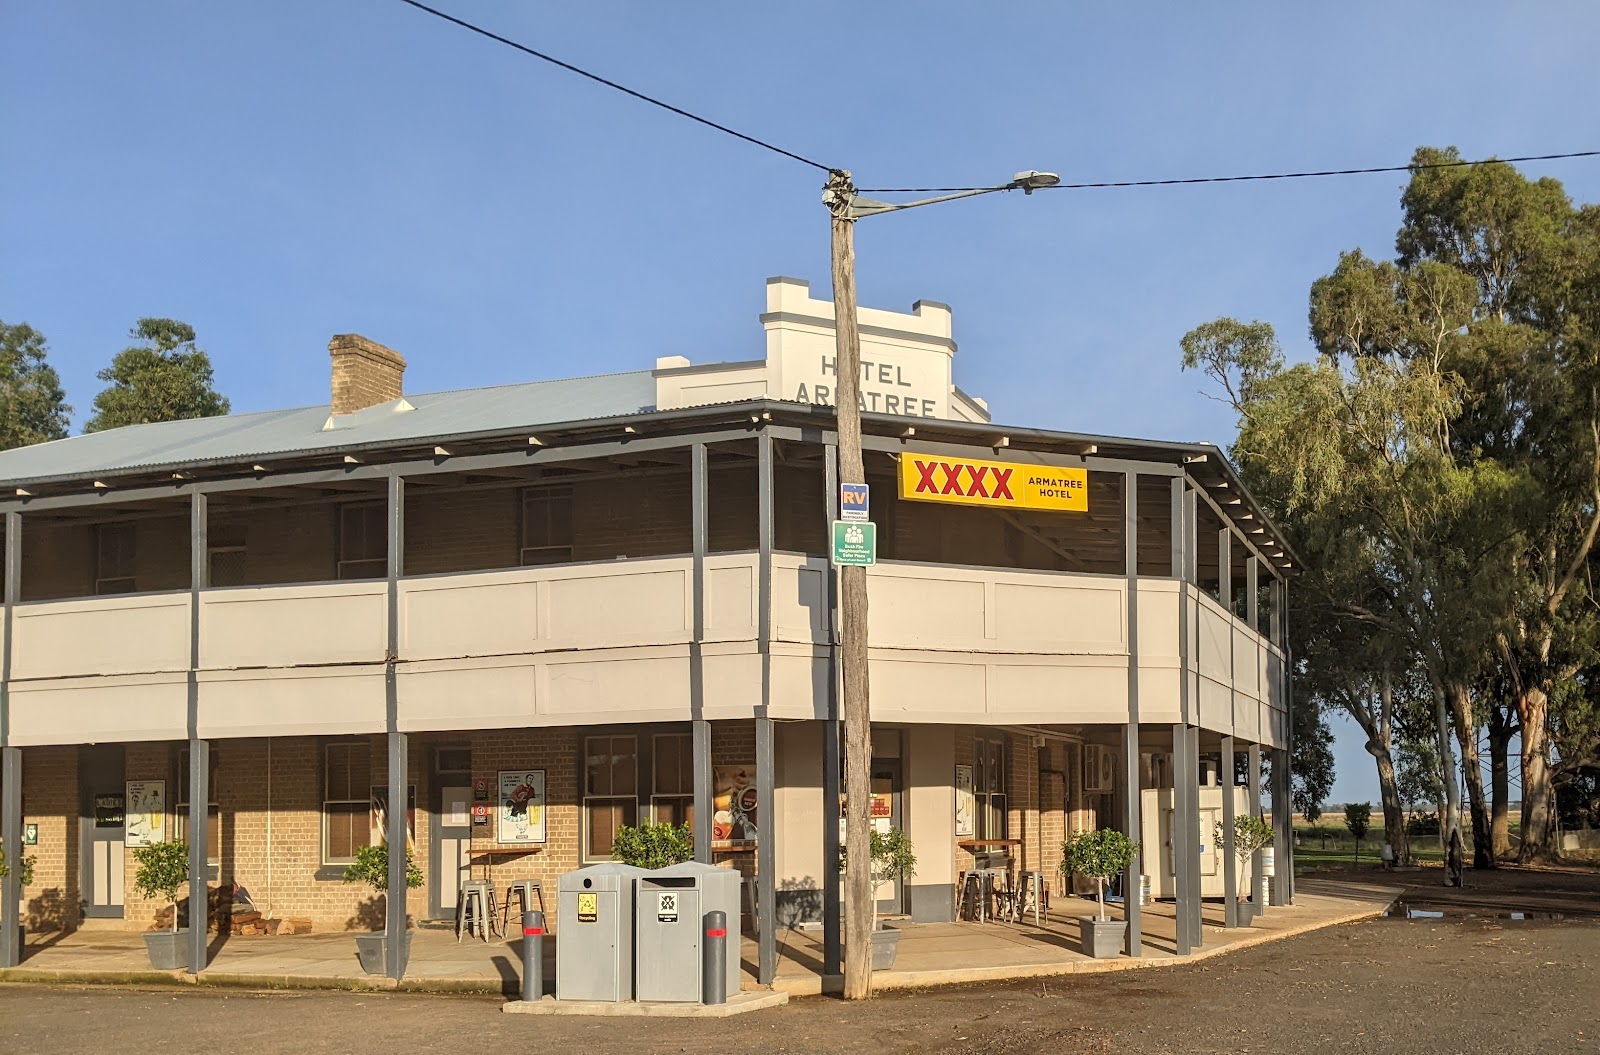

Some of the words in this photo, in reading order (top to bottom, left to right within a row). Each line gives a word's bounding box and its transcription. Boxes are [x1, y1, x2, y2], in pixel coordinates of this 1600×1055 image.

[821, 355, 911, 387] HTEL
[795, 382, 936, 418] ARATREE
[913, 460, 1015, 500] XXXX
[1028, 476, 1083, 489] ARMATREE
[843, 491, 866, 505] RV
[1039, 488, 1073, 499] HOTEL
